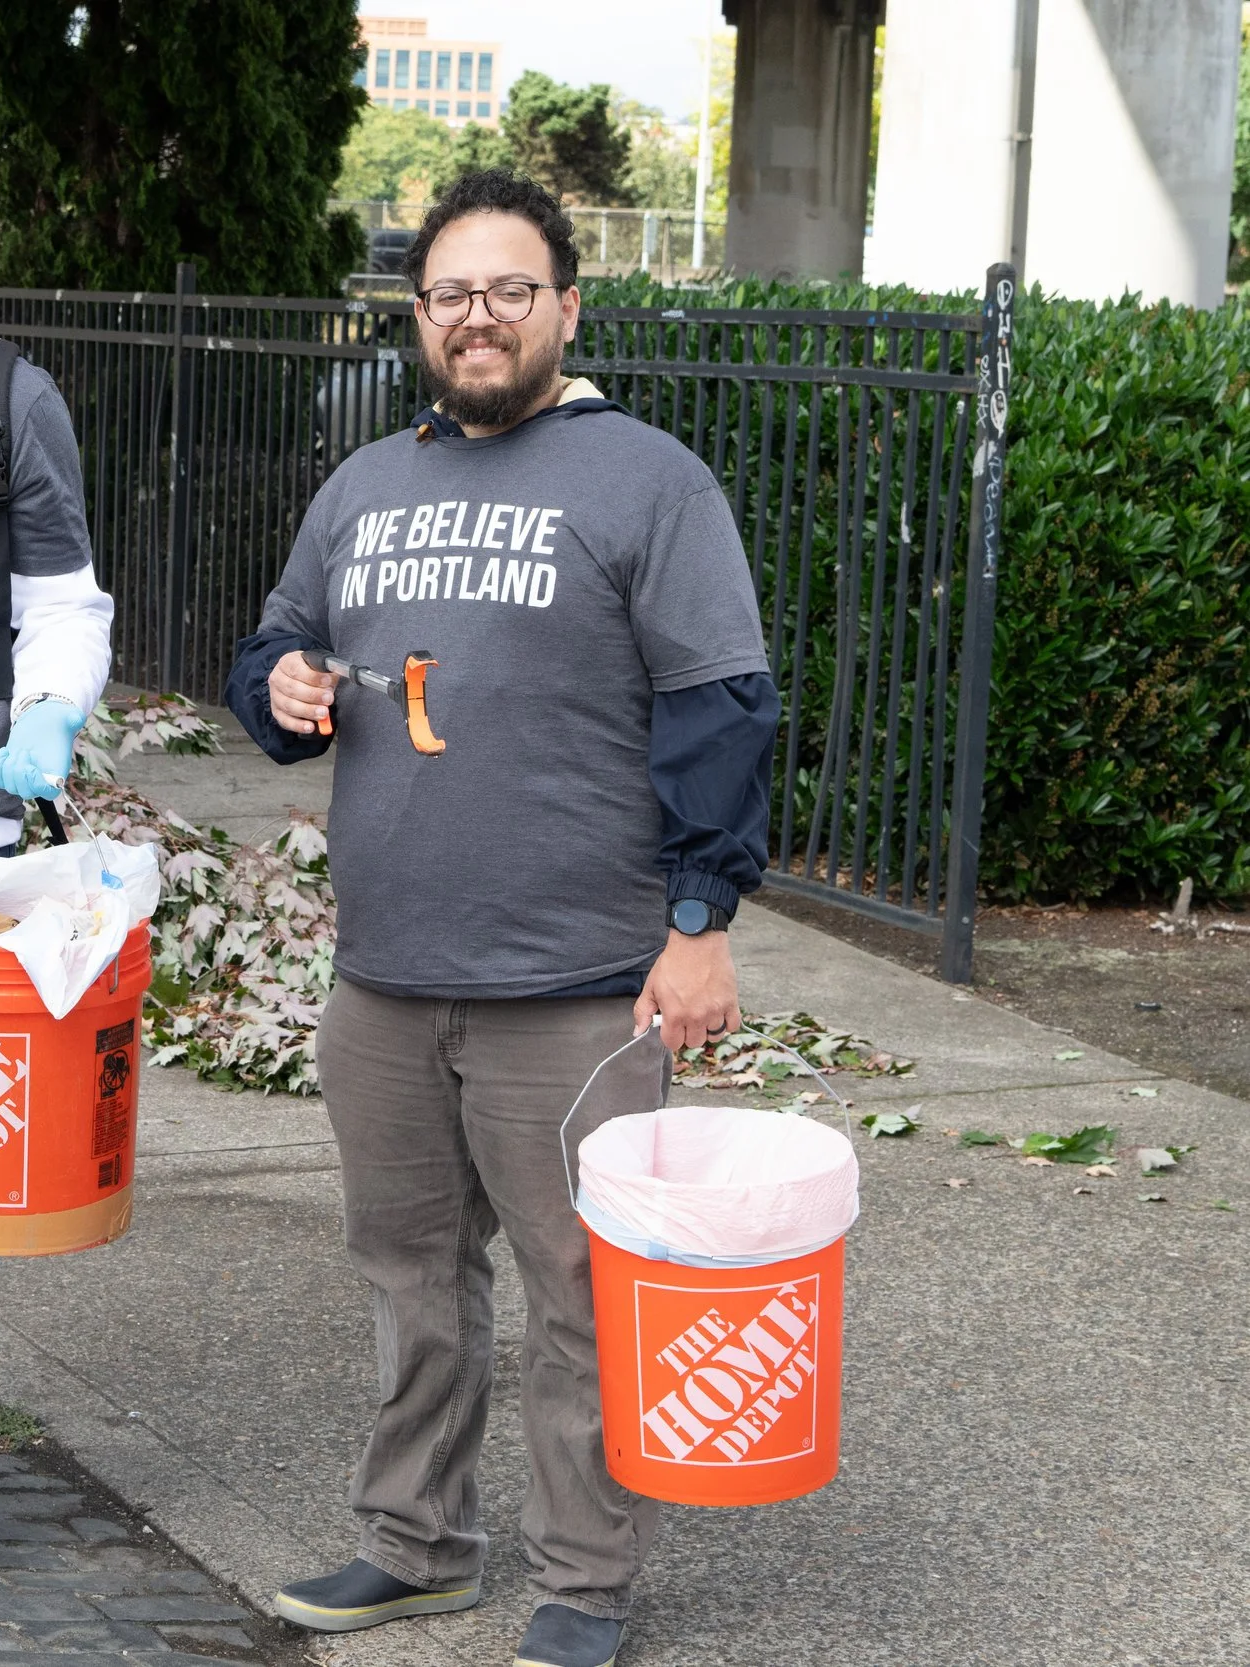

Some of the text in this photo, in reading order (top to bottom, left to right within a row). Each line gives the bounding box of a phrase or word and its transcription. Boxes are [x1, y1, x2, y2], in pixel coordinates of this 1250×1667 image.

[353, 501, 564, 558] WE BELIEVE
[340, 556, 557, 610] IN PORTLAND
[642, 1283, 818, 1461] HOME
[655, 1307, 737, 1376] THE
[711, 1344, 815, 1463] DEPOT
